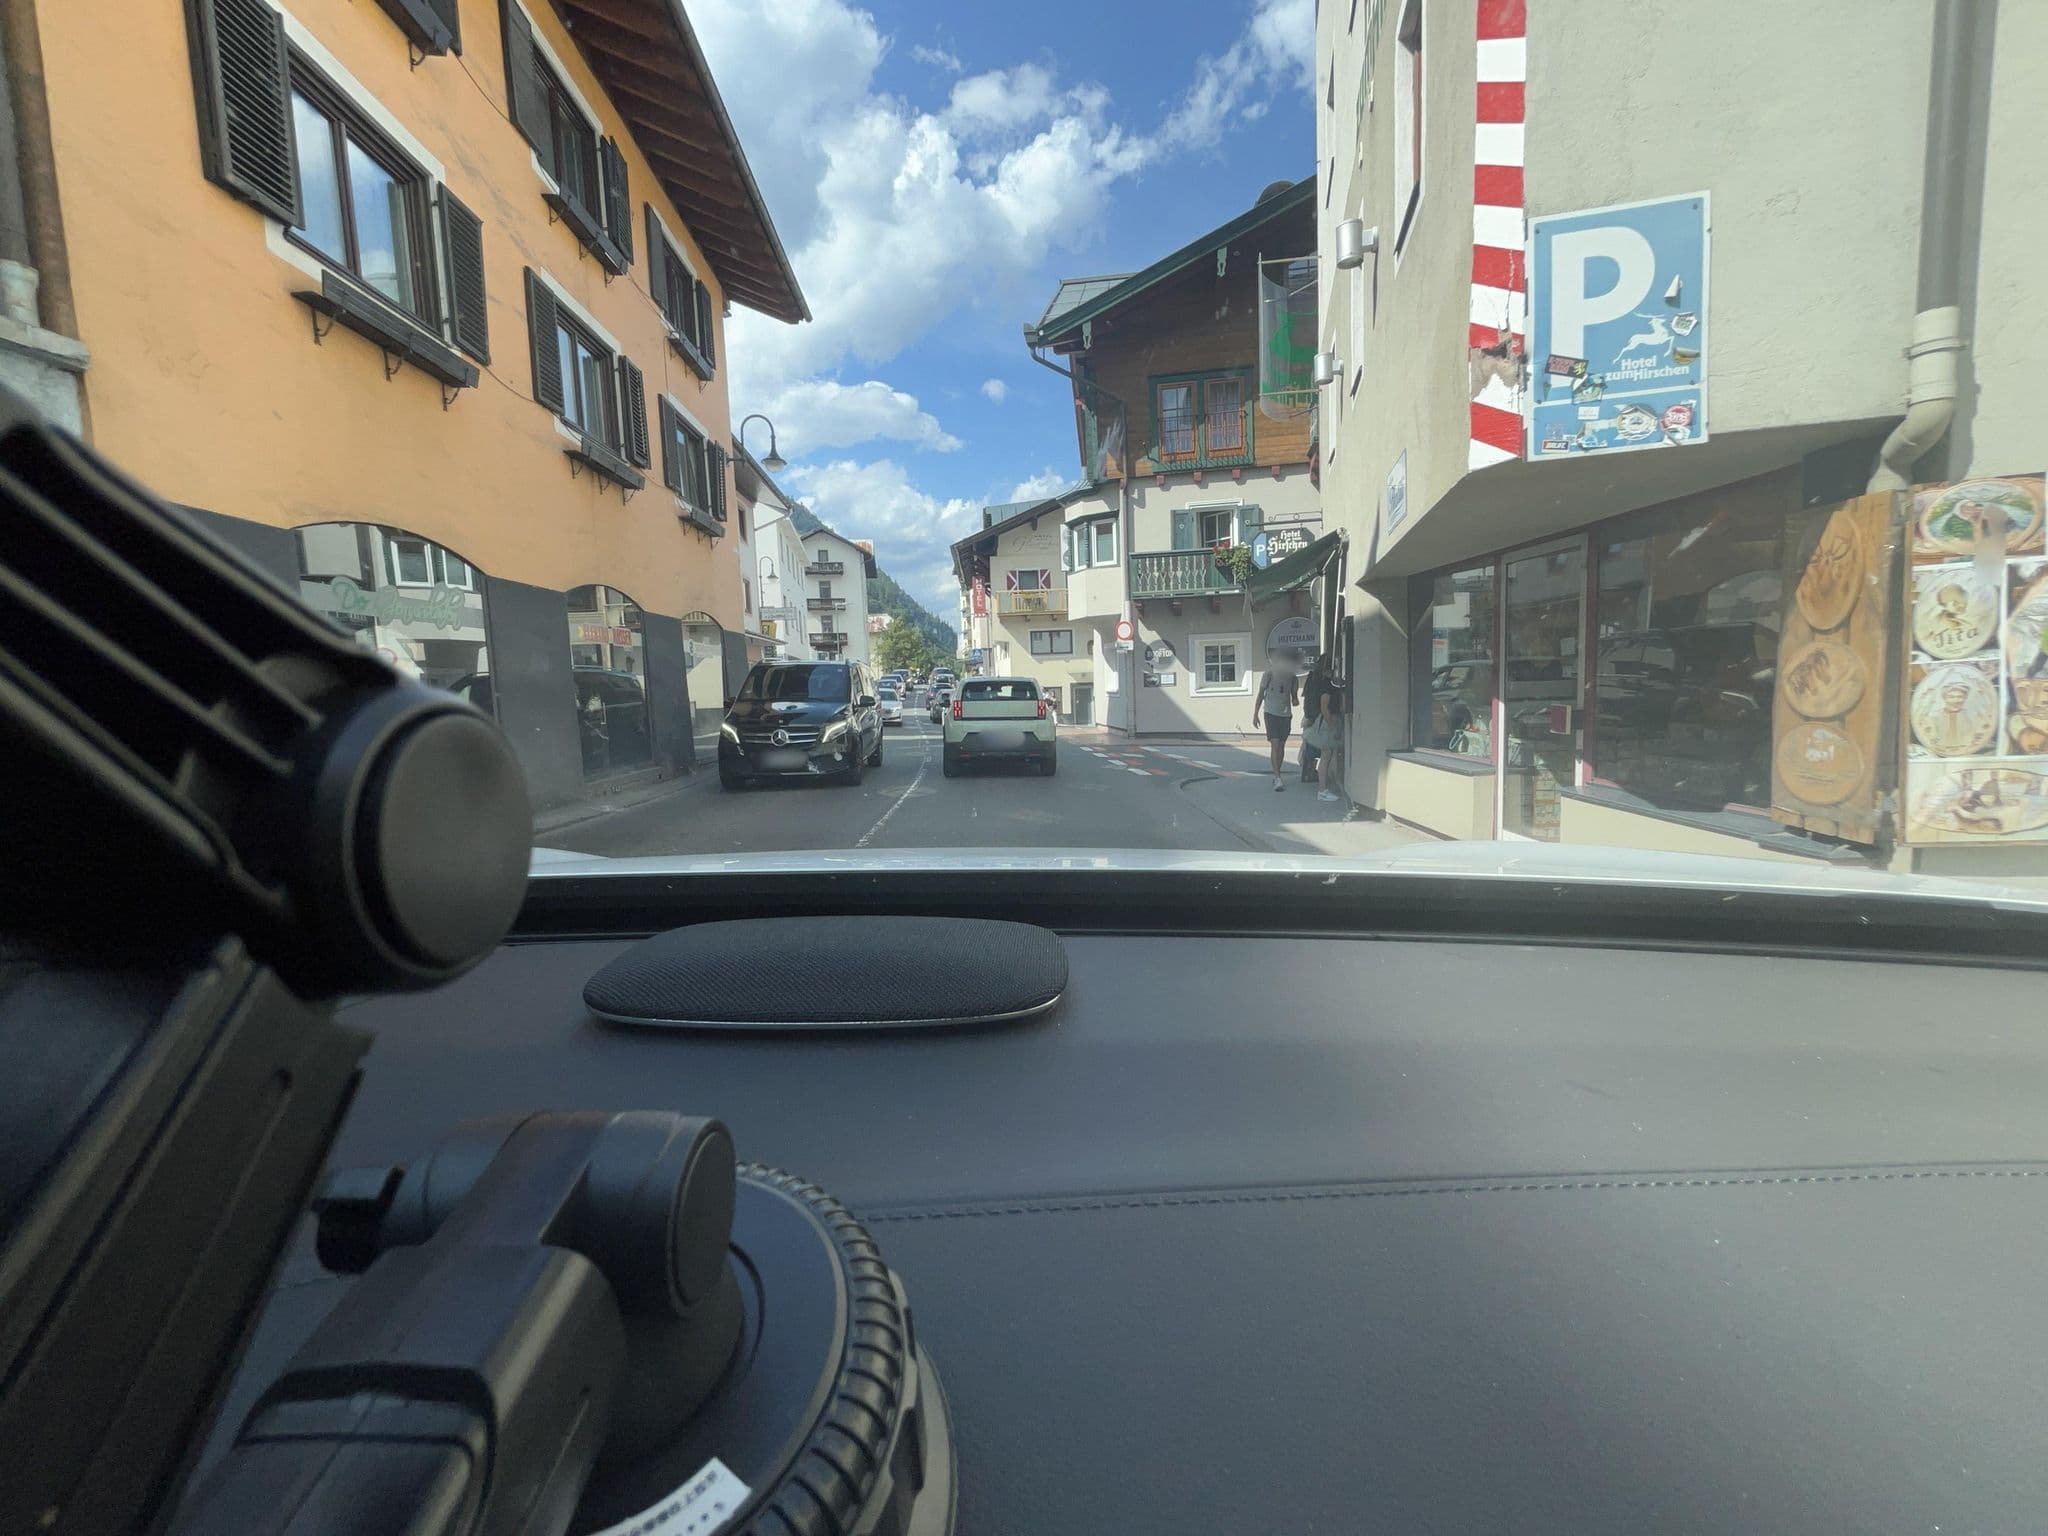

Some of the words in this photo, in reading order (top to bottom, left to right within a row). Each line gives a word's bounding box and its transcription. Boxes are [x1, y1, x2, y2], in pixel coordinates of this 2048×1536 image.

[1551, 226, 1655, 388] P
[1621, 355, 1657, 371] Hotel
[1280, 530, 1301, 540] Hotel
[1256, 544, 1265, 557] P
[975, 577, 983, 607] HOTEL
